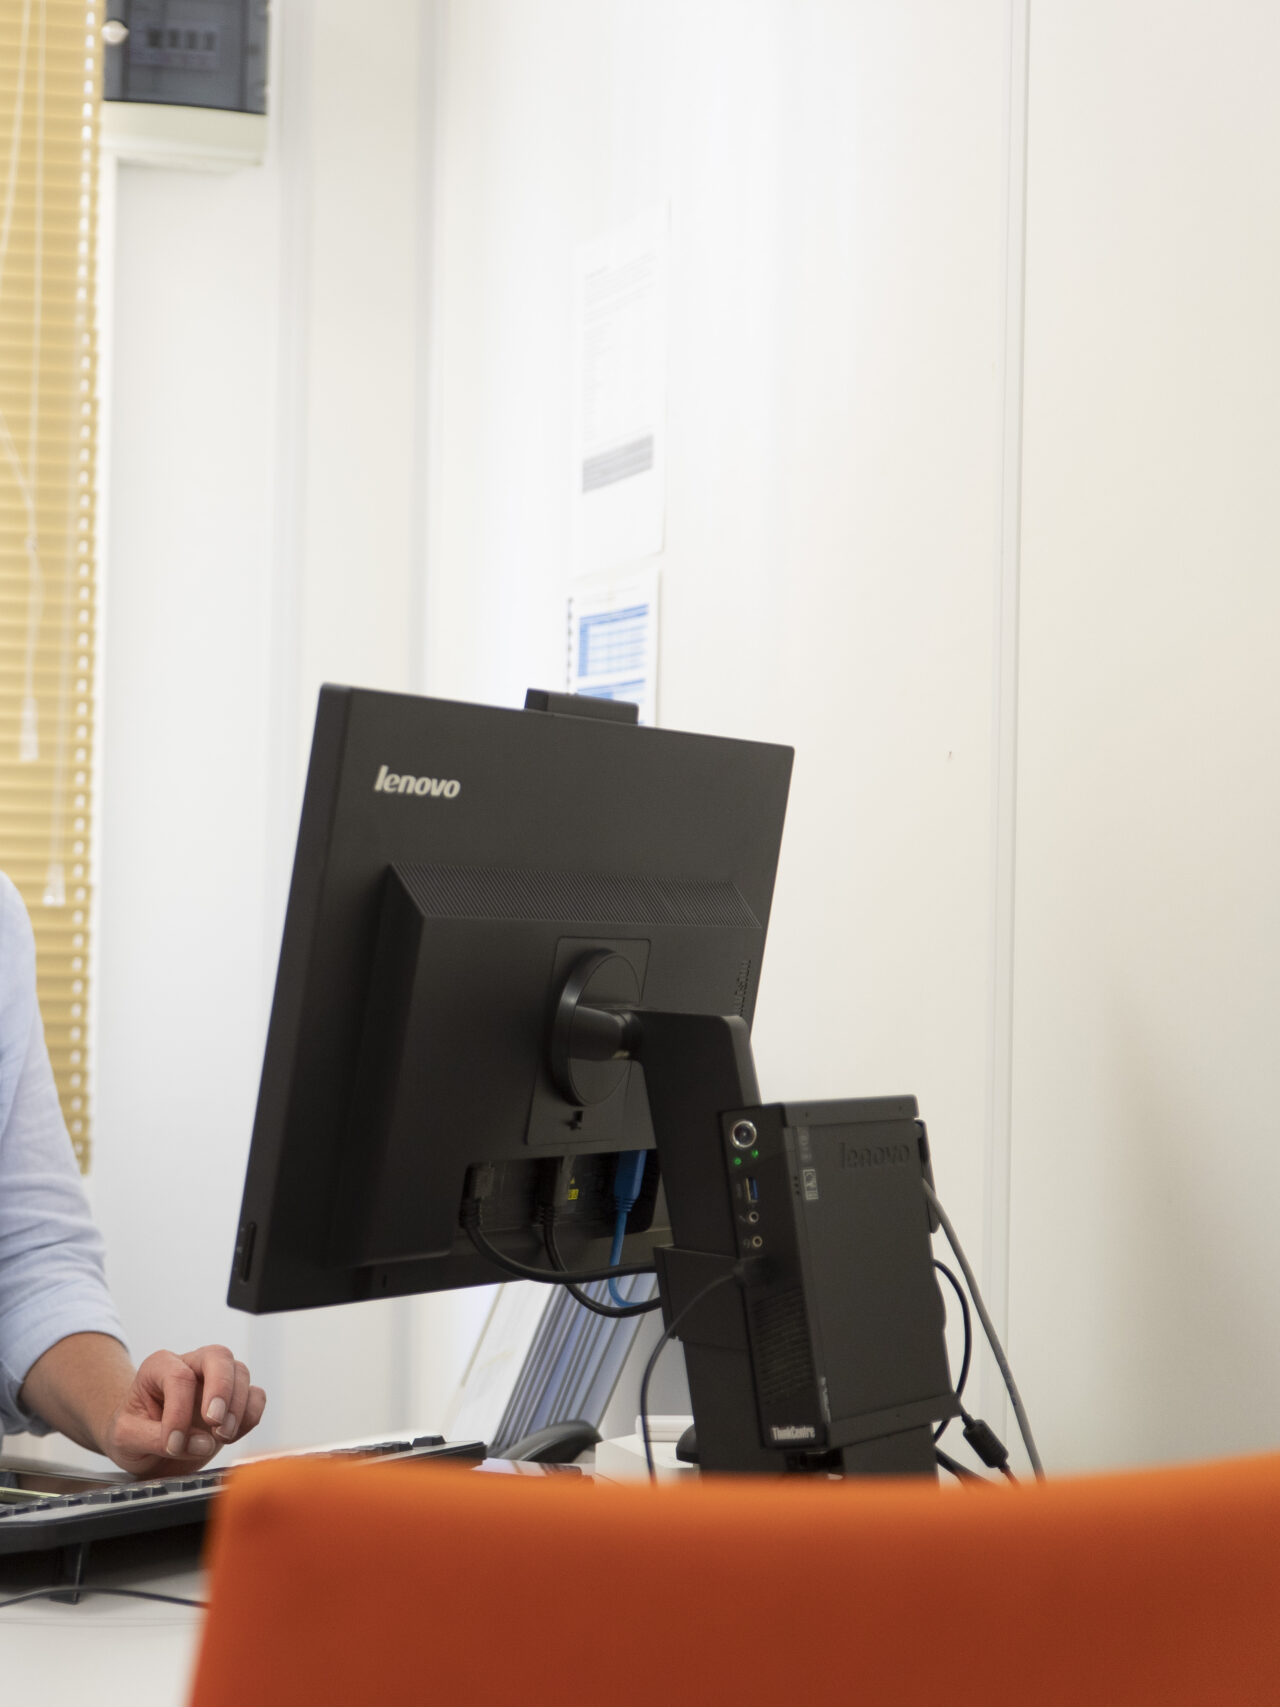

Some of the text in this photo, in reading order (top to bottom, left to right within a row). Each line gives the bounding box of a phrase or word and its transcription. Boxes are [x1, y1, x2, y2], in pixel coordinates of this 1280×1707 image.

[374, 765, 461, 798] lenovo
[840, 1142, 911, 1169] lenovo
[771, 1425, 816, 1441] ThinkCentre
